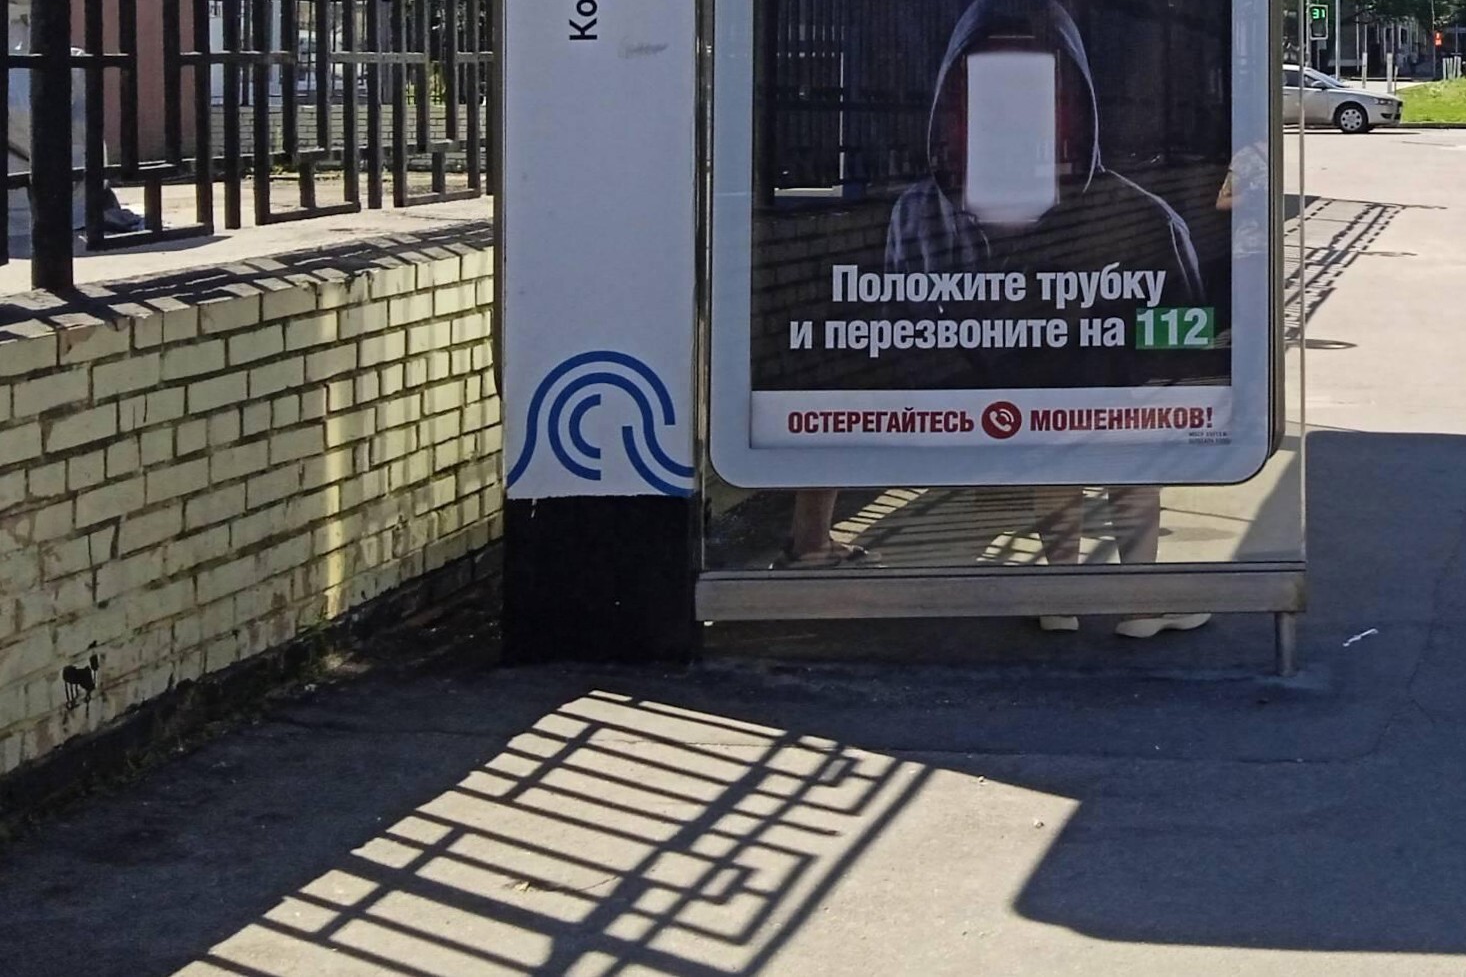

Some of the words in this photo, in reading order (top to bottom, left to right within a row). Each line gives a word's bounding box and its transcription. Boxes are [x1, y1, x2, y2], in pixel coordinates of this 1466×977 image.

[831, 263, 1027, 304] Положите
[1036, 261, 1167, 309] трубку
[789, 319, 813, 351] и
[823, 316, 1069, 359] перезвоните
[1078, 316, 1126, 348] на
[1136, 307, 1210, 347] 112
[786, 406, 975, 434] ОСТЕРЕГАЙТЕСЬ
[1030, 406, 1214, 431] МОШЕННИКОВ!
